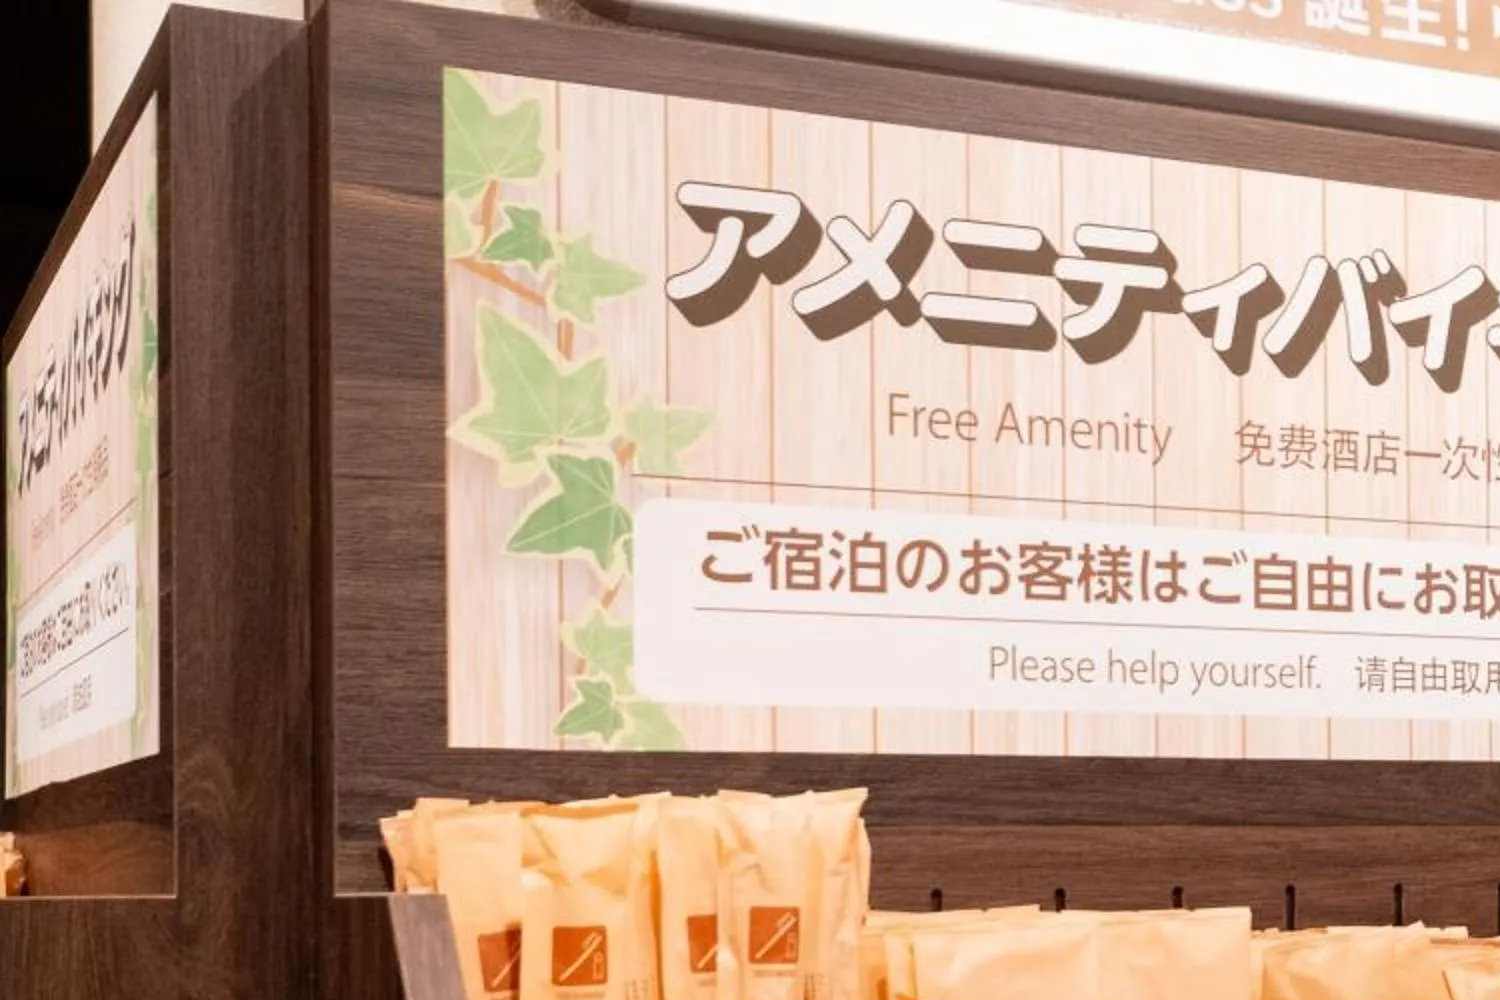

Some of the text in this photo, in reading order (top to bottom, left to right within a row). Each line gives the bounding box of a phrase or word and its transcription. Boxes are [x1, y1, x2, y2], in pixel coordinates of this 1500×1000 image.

[887, 393, 1172, 466] Free Amenity
[989, 645, 1322, 695] Please help yourself.
